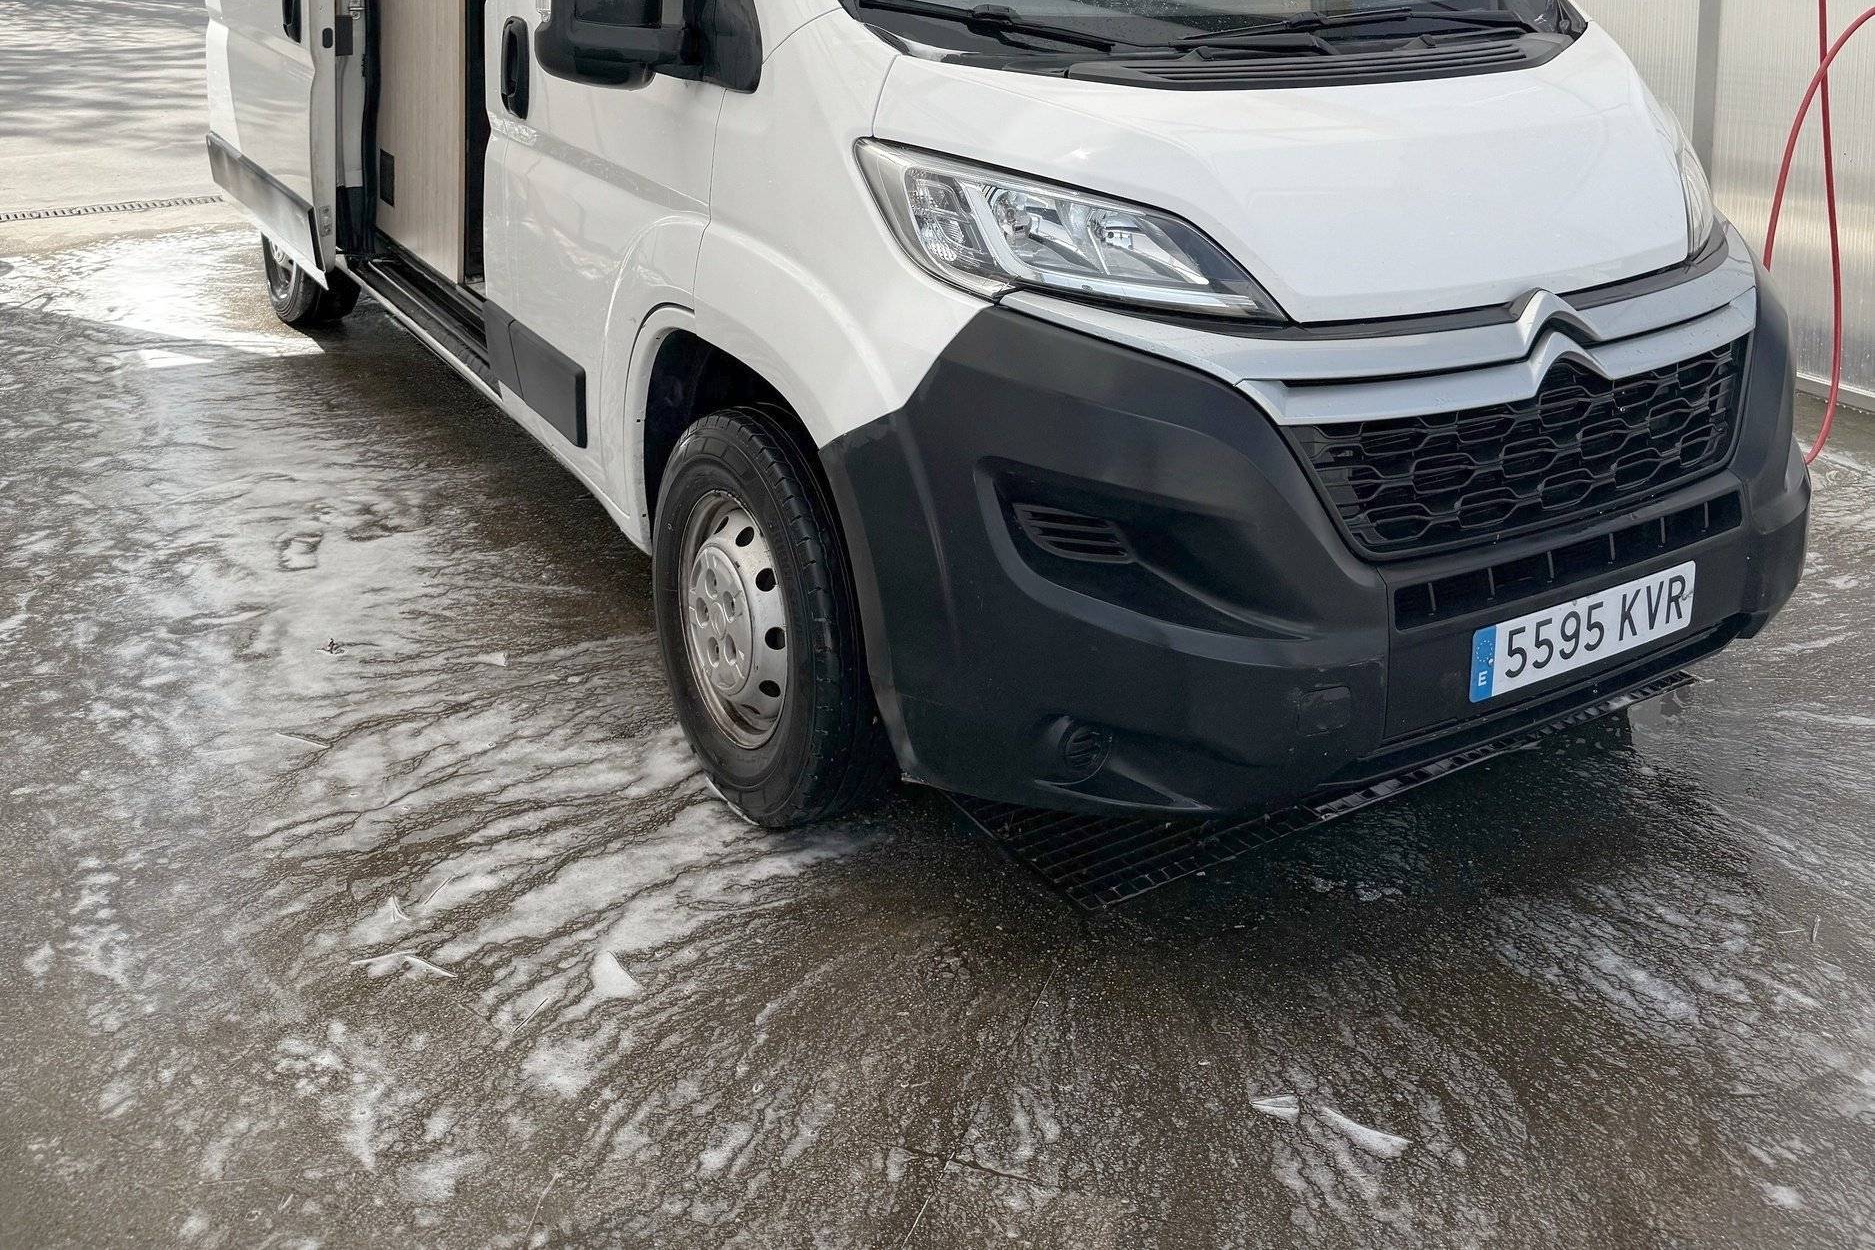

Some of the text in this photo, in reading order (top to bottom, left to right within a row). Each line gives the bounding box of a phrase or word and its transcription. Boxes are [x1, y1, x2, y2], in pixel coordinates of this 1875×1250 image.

[1504, 574, 1687, 679] 5595 KVR
[1477, 670, 1488, 687] E
